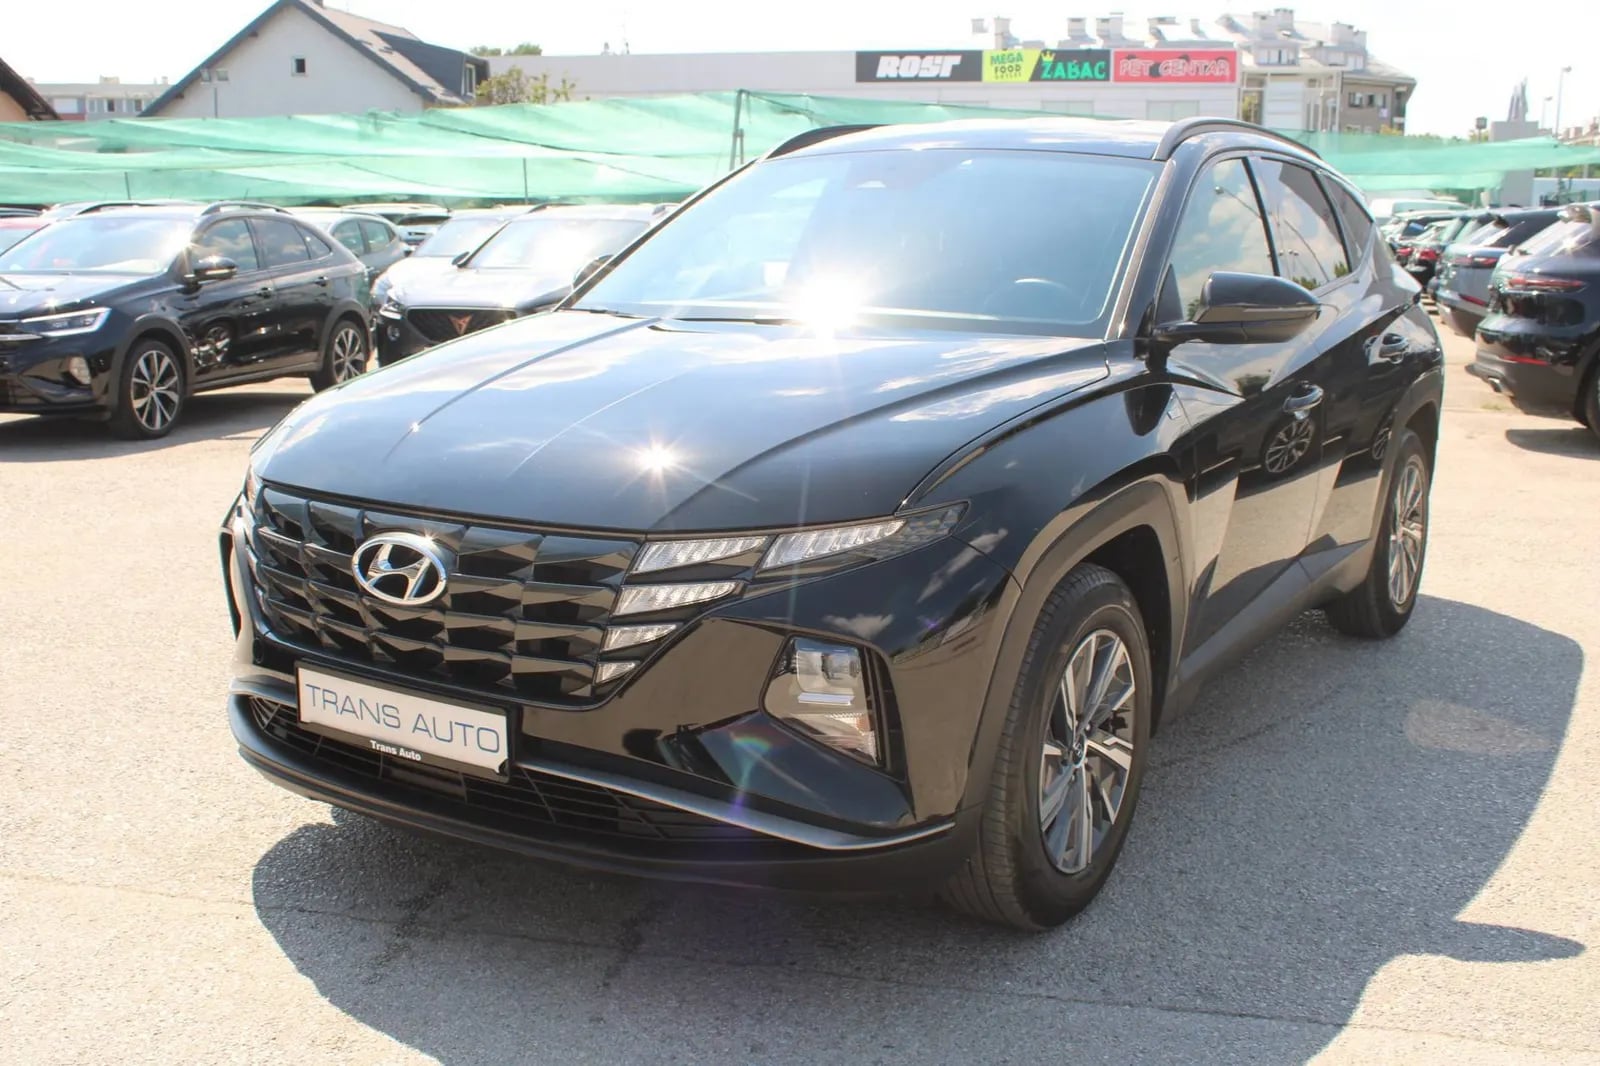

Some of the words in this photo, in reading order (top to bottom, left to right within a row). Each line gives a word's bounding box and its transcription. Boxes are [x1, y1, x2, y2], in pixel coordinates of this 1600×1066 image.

[990, 52, 1023, 66] MEGA
[1119, 58, 1154, 76] PET
[1159, 58, 1230, 76] CENTAR
[994, 64, 1021, 74] FOOD
[305, 683, 400, 729] TRANS
[412, 713, 500, 753] AUTO
[369, 739, 397, 755] Trans
[399, 747, 422, 762] Auto
